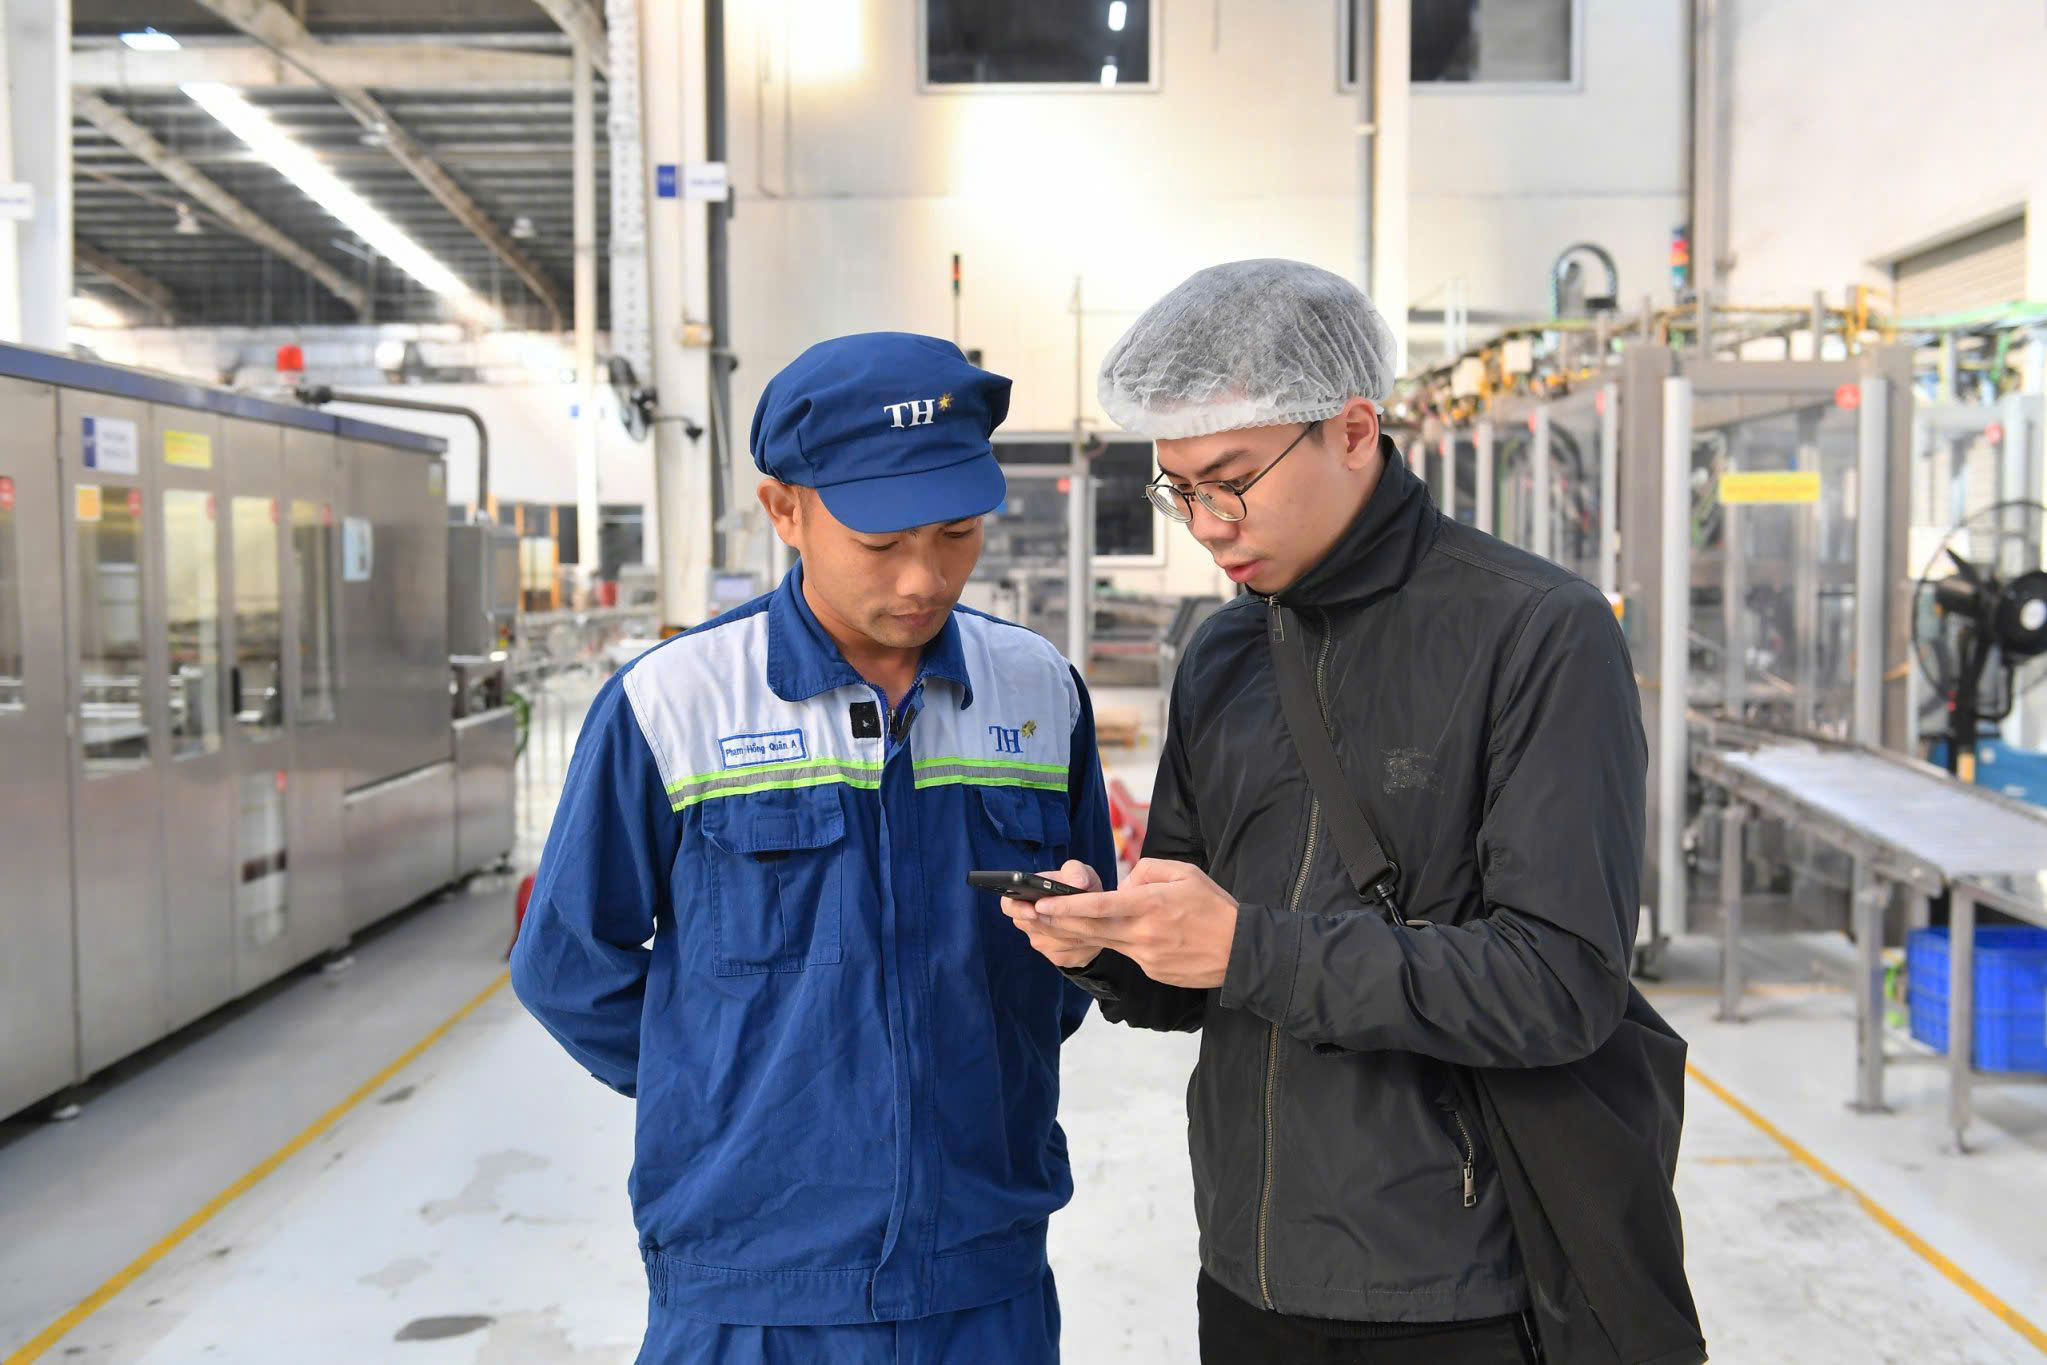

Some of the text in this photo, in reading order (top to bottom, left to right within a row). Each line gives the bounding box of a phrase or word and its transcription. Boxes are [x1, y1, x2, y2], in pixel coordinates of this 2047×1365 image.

[883, 399, 935, 428] TH
[791, 739, 797, 748] A
[989, 726, 1024, 753] TH
